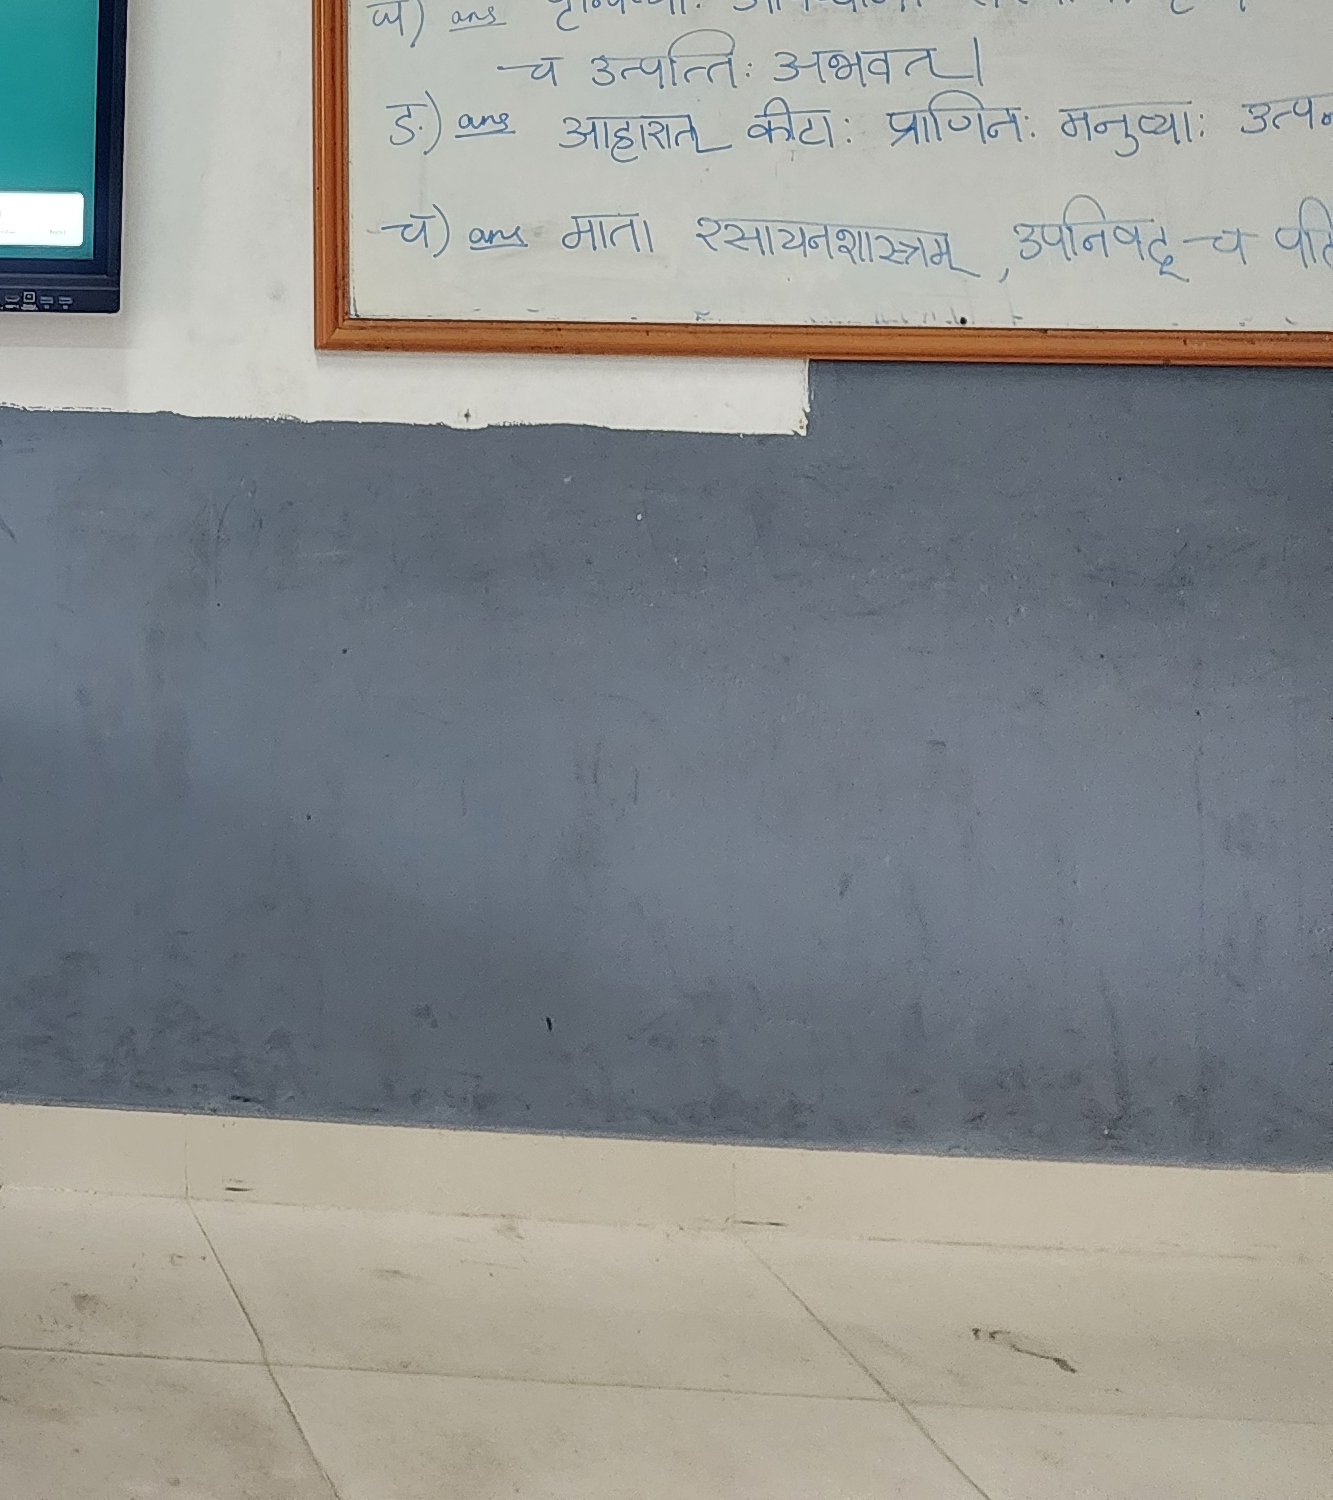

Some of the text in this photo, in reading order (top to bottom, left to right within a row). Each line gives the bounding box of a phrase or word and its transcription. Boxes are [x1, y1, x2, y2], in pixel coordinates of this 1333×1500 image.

[450, 3, 498, 25] ans
[496, 56, 564, 88] च
[456, 110, 510, 132] ans
[468, 224, 528, 246] ans
[1182, 228, 1259, 266] च
